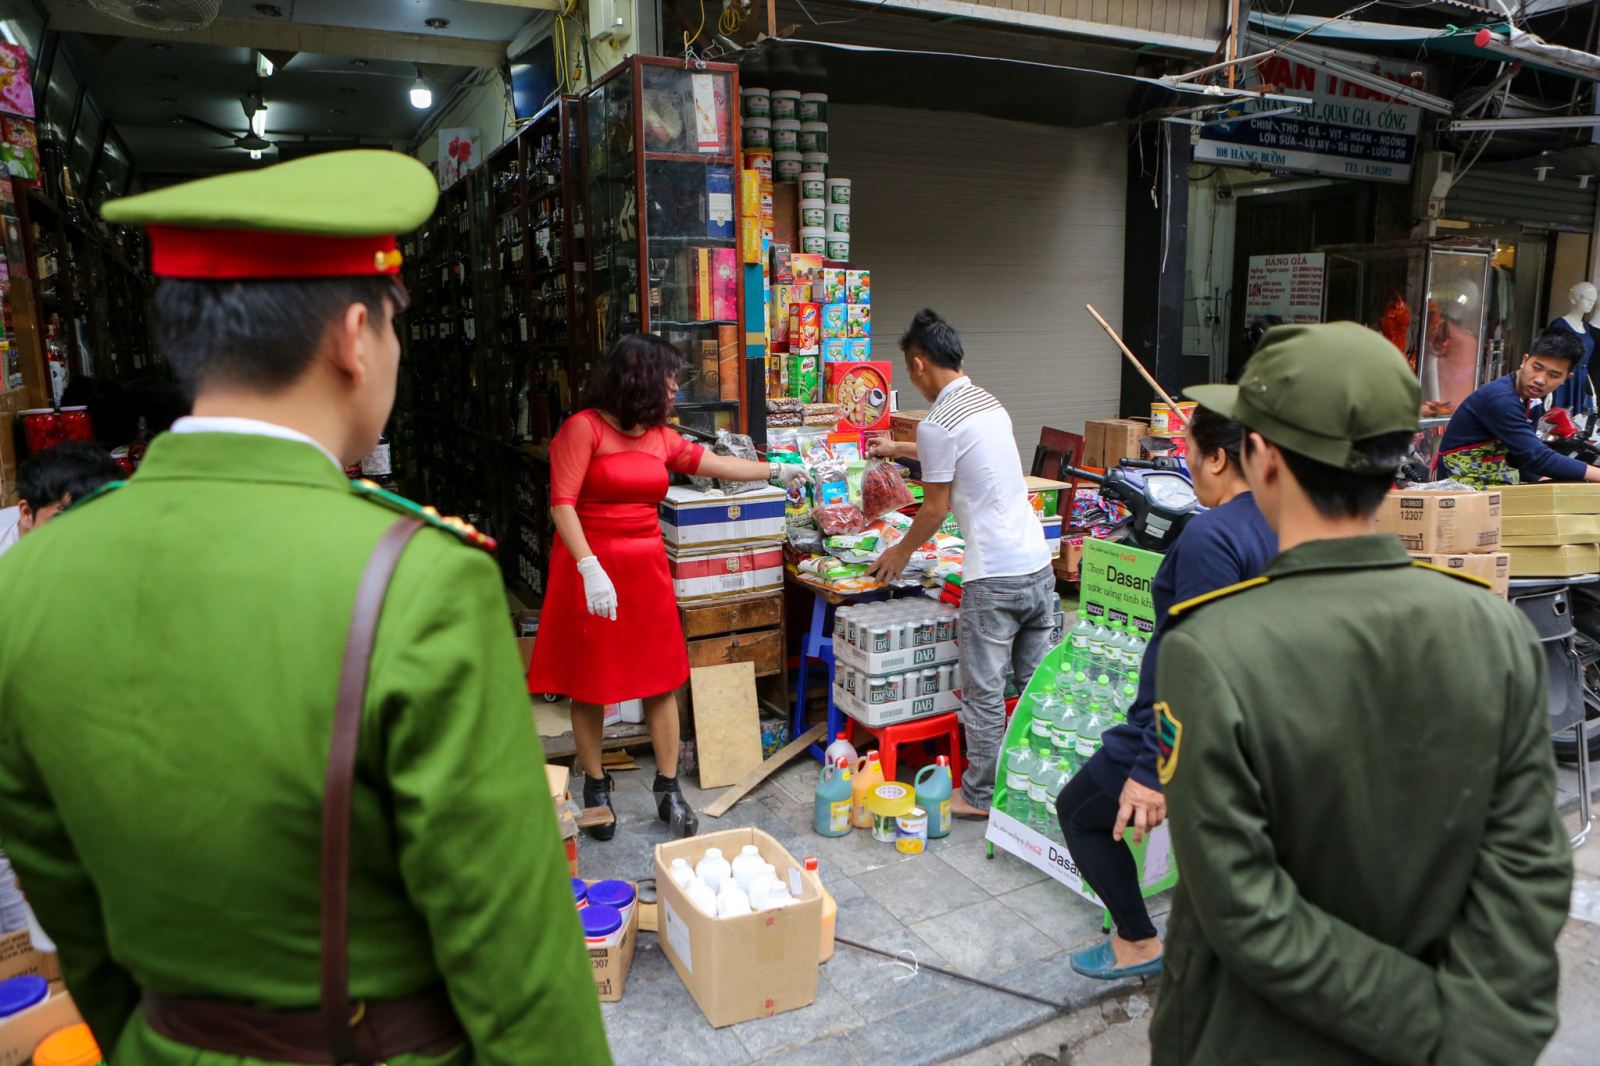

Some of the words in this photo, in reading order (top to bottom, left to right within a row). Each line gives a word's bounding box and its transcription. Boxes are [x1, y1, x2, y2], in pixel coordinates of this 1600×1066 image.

[1323, 103, 1350, 123] QUAY
[1353, 108, 1370, 126] GIA
[1378, 109, 1407, 130] CÔNG
[1216, 147, 1228, 157] 108
[1231, 147, 1258, 162] HÀNG
[1400, 511, 1423, 521] 12307
[1106, 565, 1154, 593] Dasani
[915, 648, 934, 663] DAB
[914, 698, 933, 713] DAB
[1049, 846, 1080, 876] Dasa
